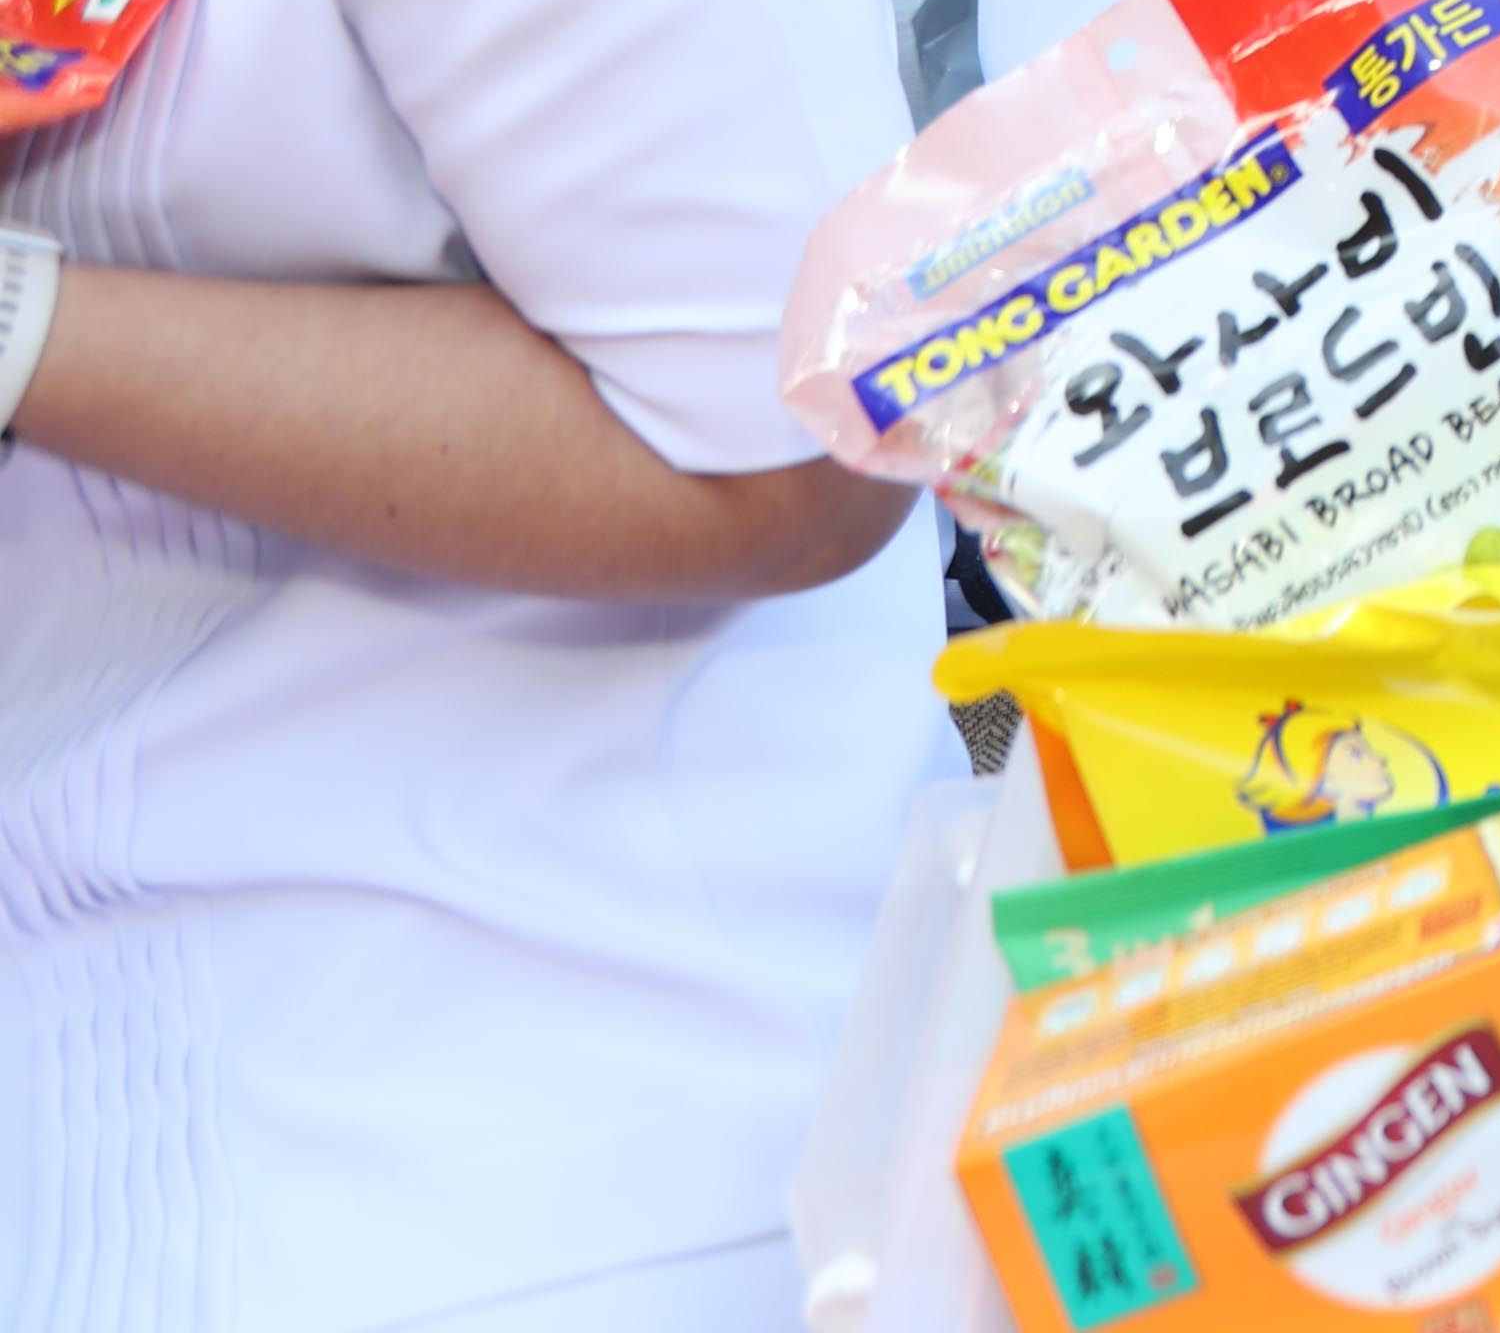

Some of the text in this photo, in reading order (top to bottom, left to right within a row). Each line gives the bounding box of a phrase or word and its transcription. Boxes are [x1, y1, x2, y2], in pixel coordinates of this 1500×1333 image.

[872, 293, 1045, 414] TONG
[1045, 151, 1273, 315] GARDEN
[1066, 147, 1443, 468] 와사비
[1302, 430, 1435, 529] BROAD
[1263, 1042, 1492, 1239] GINGEN
